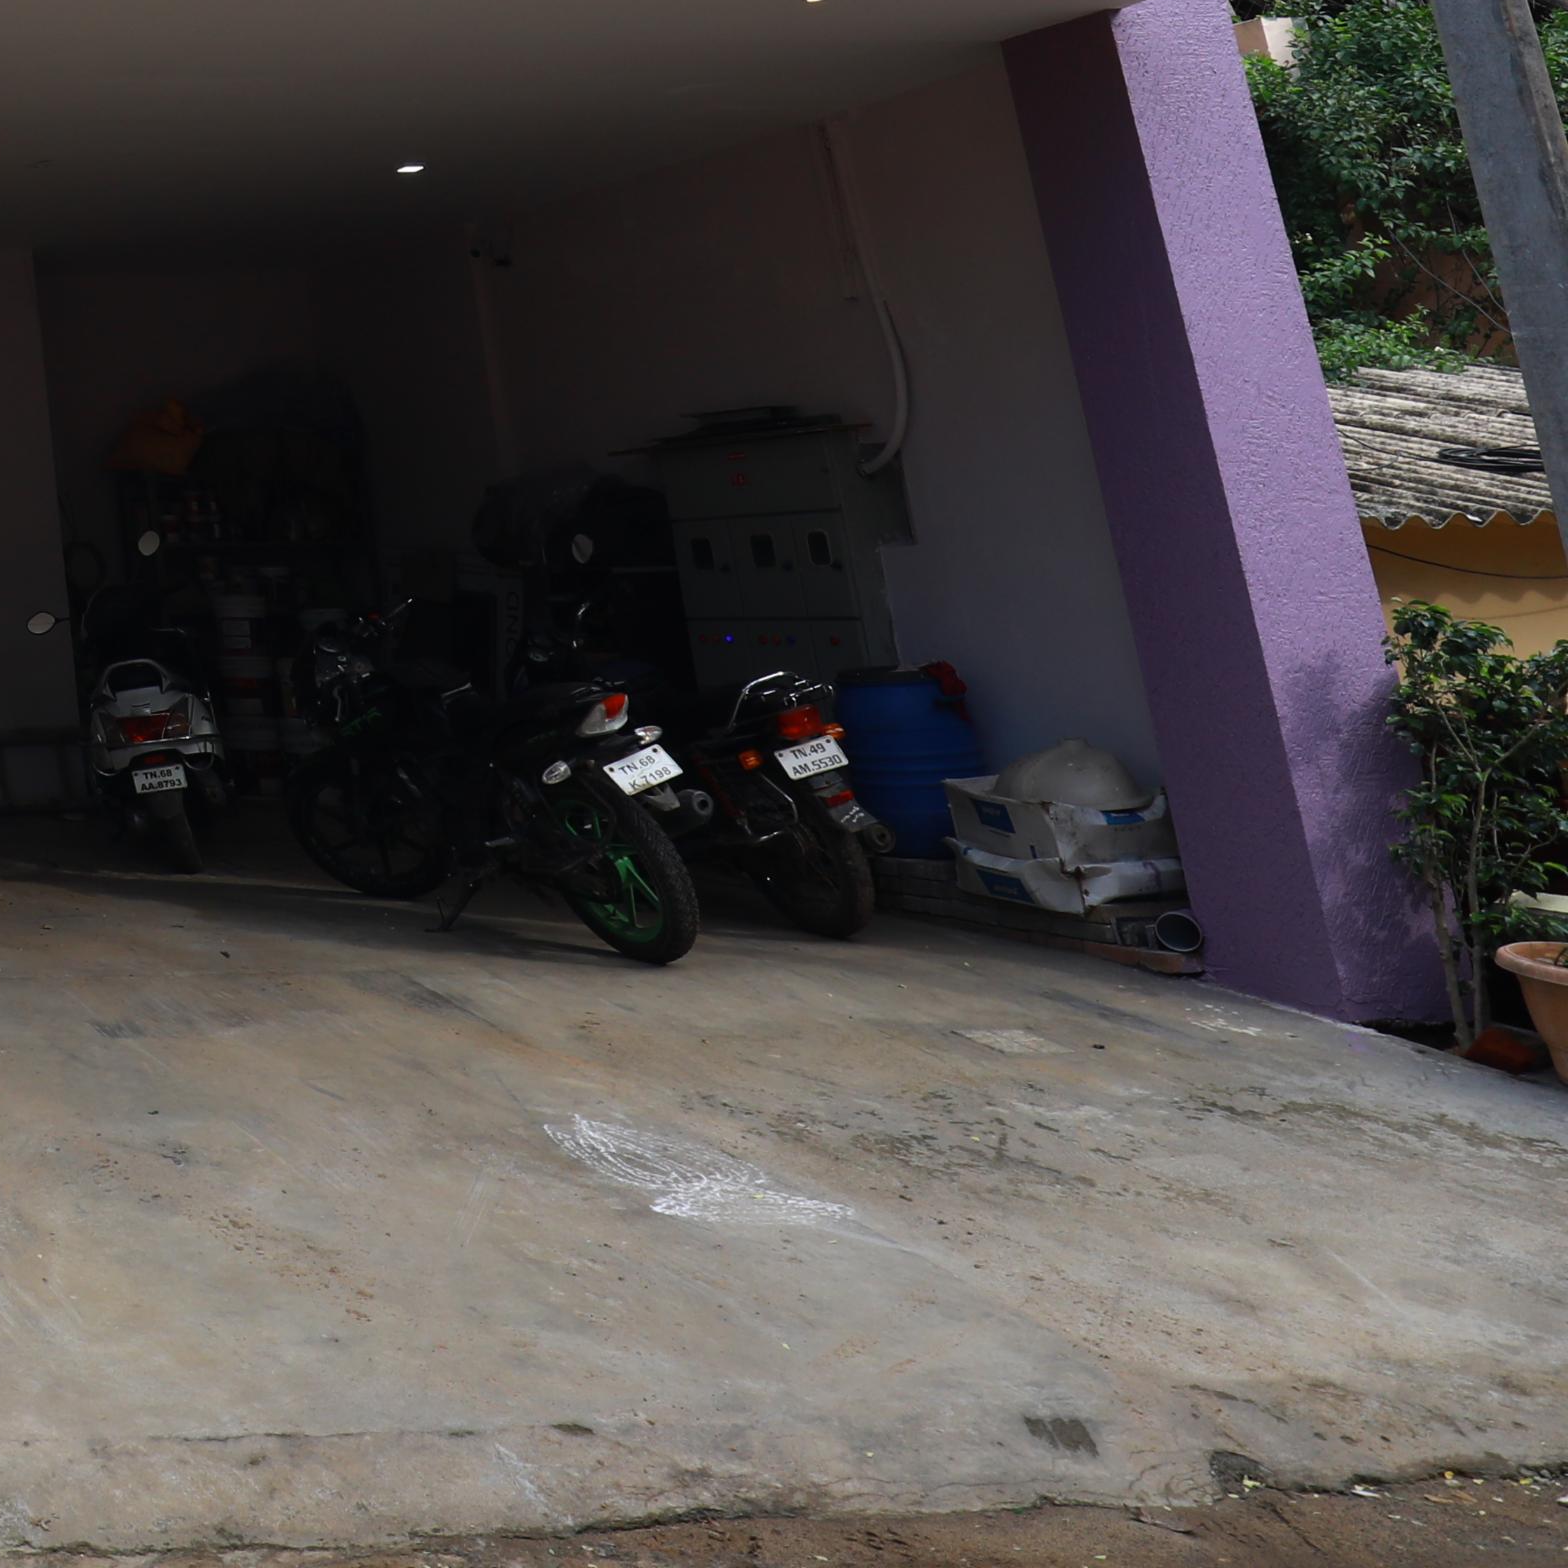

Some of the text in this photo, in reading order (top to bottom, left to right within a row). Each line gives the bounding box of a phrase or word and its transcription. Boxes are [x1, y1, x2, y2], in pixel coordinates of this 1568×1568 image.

[790, 742, 826, 760] TN.49
[142, 770, 173, 779] TN.68
[618, 754, 655, 777] TN.68
[791, 754, 844, 777] AM.5530
[628, 765, 672, 792] K.7198
